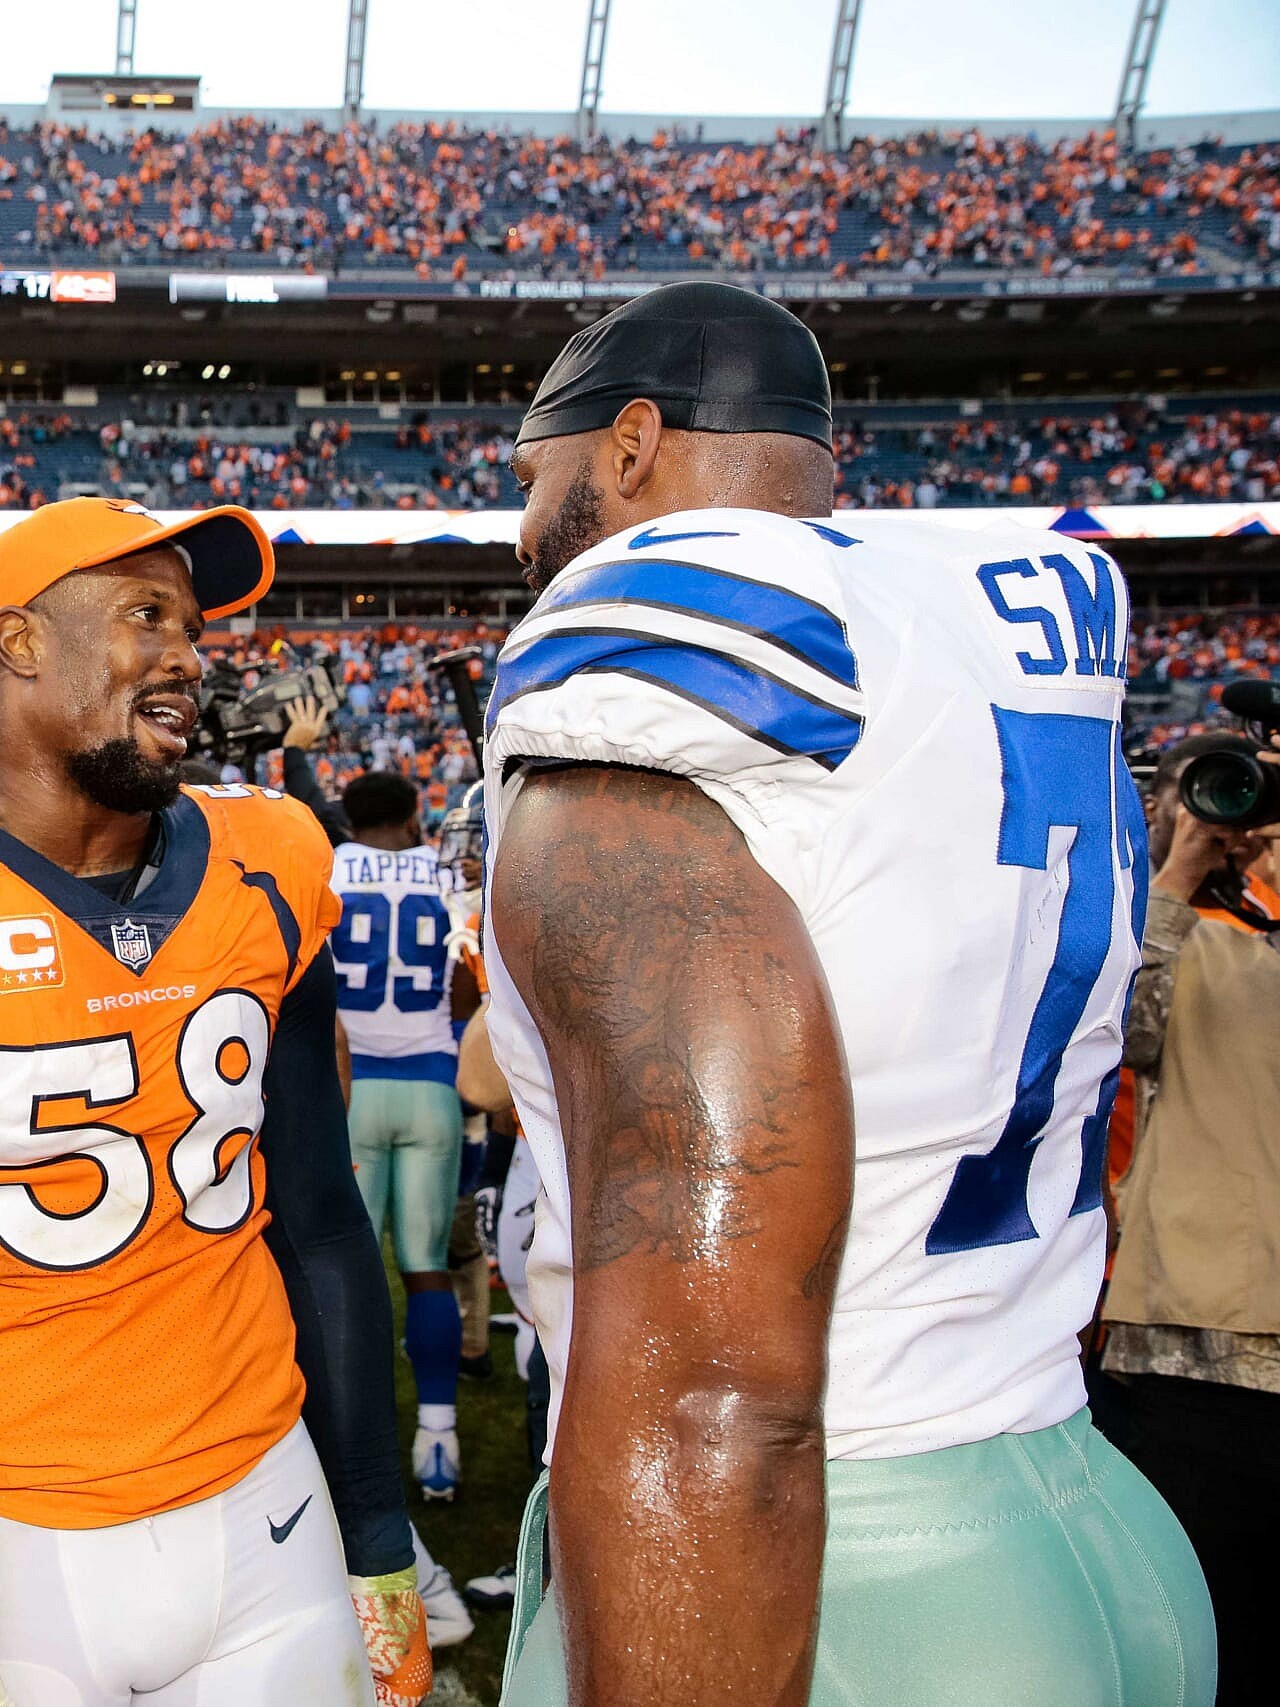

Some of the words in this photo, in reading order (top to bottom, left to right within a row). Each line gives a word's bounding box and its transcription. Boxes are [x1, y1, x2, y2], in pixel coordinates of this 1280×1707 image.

[23, 274, 51, 298] 17
[515, 281, 584, 299] BOWLEN
[121, 941, 146, 960] NFL
[331, 892, 452, 1012] 99
[86, 985, 197, 1014] BRONCOS
